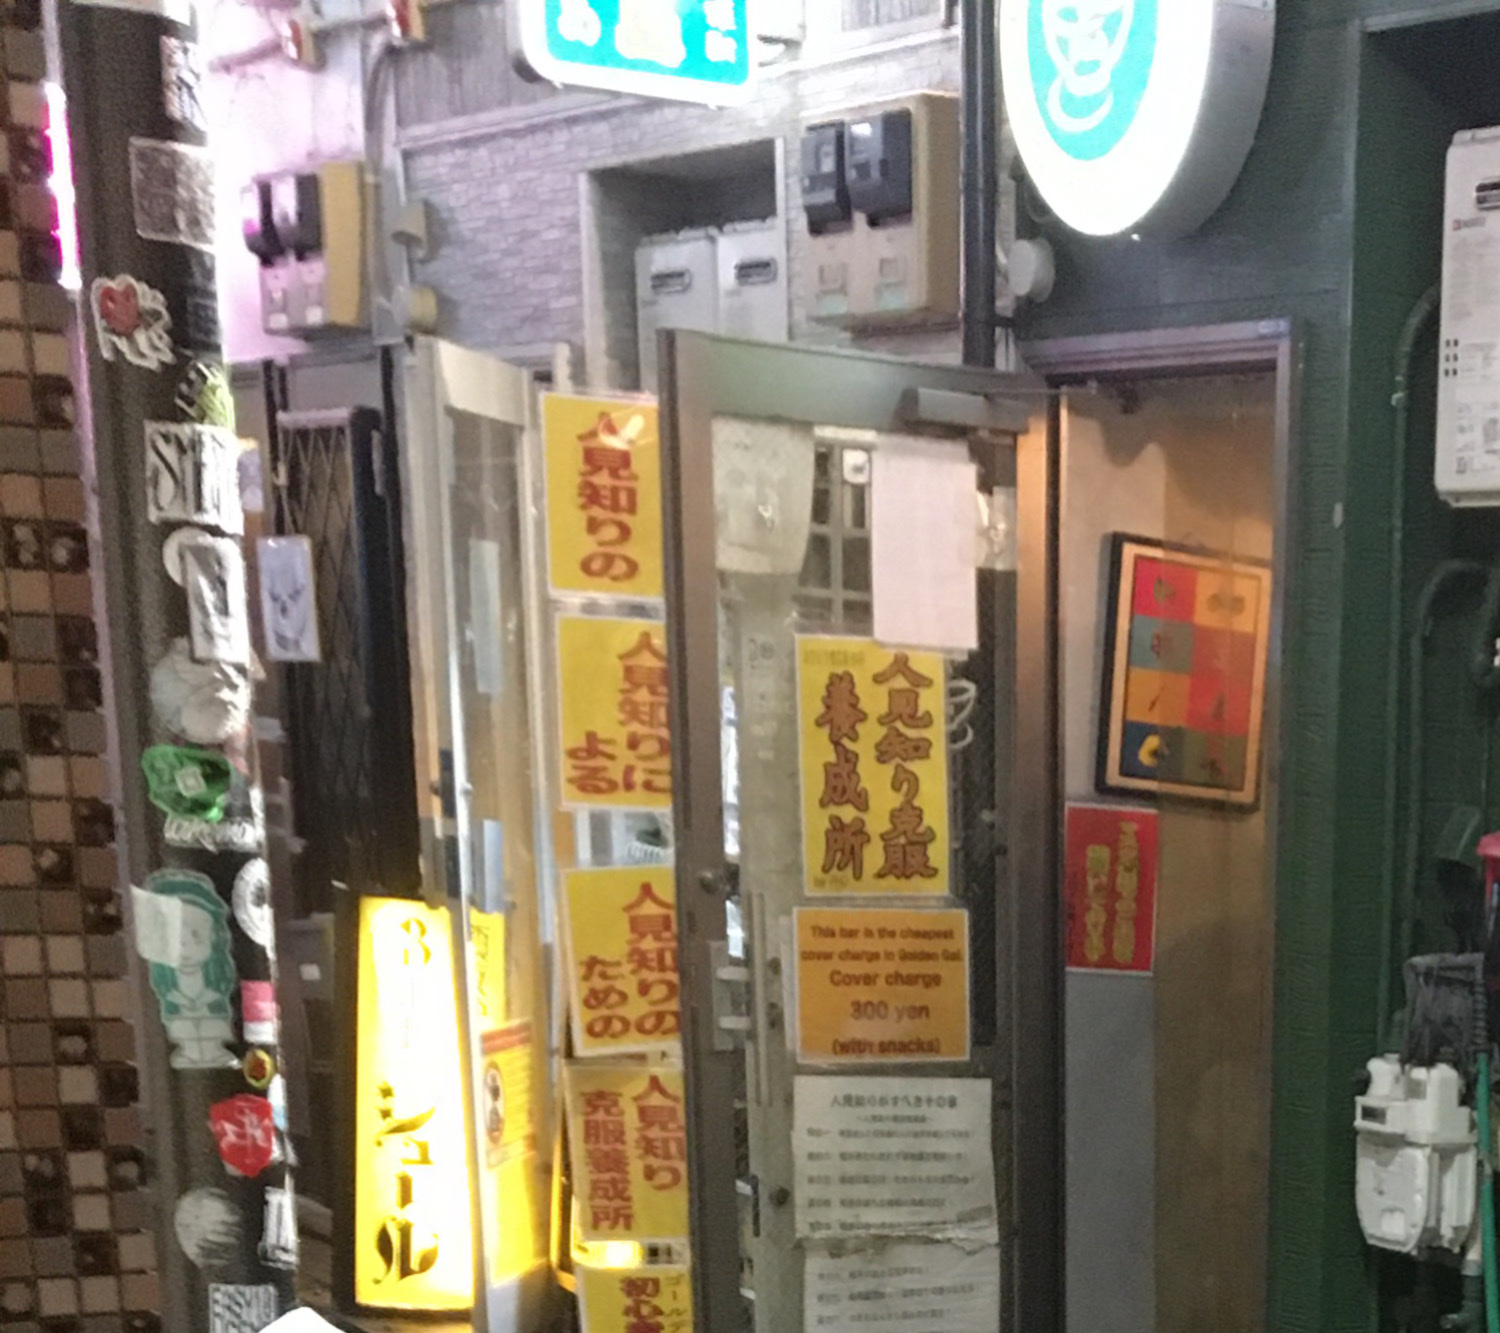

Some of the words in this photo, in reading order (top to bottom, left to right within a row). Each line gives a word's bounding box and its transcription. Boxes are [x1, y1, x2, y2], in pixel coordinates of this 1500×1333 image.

[576, 410, 640, 582] 人見知りの
[564, 730, 619, 795] よる
[617, 630, 673, 794] 人見知りに
[814, 670, 871, 882] 養成所
[872, 651, 938, 880] 人見知り克服
[579, 954, 632, 1039] ための
[622, 881, 684, 1037] 人見知りの
[811, 925, 837, 939] This
[839, 926, 860, 939] bar
[877, 927, 897, 940] the
[829, 969, 880, 987] Cover
[884, 970, 942, 989] charge
[850, 1000, 889, 1021] 300
[894, 1004, 931, 1023] yen
[580, 1090, 633, 1231] 克服養成所
[632, 1075, 685, 1191] 人見知り
